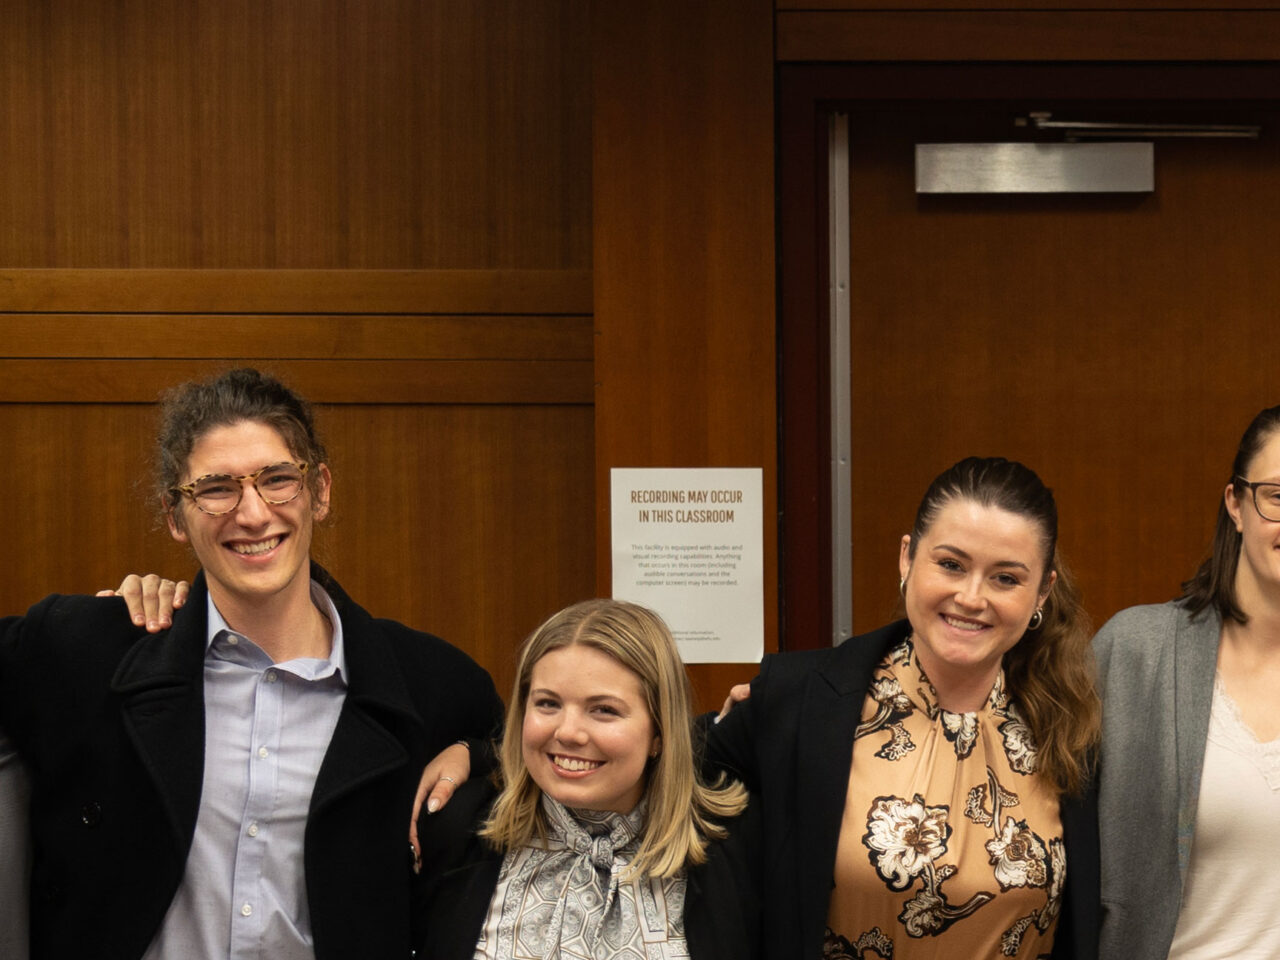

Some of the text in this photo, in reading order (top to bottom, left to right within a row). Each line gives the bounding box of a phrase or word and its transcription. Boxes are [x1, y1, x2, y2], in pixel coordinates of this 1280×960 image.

[631, 490, 743, 504] RECORDING MAY OCCUR
[639, 510, 734, 523] IN THIS CLASSROOM
[671, 544, 698, 552] equipped
[651, 553, 679, 561] recording
[715, 553, 742, 561] Anything
